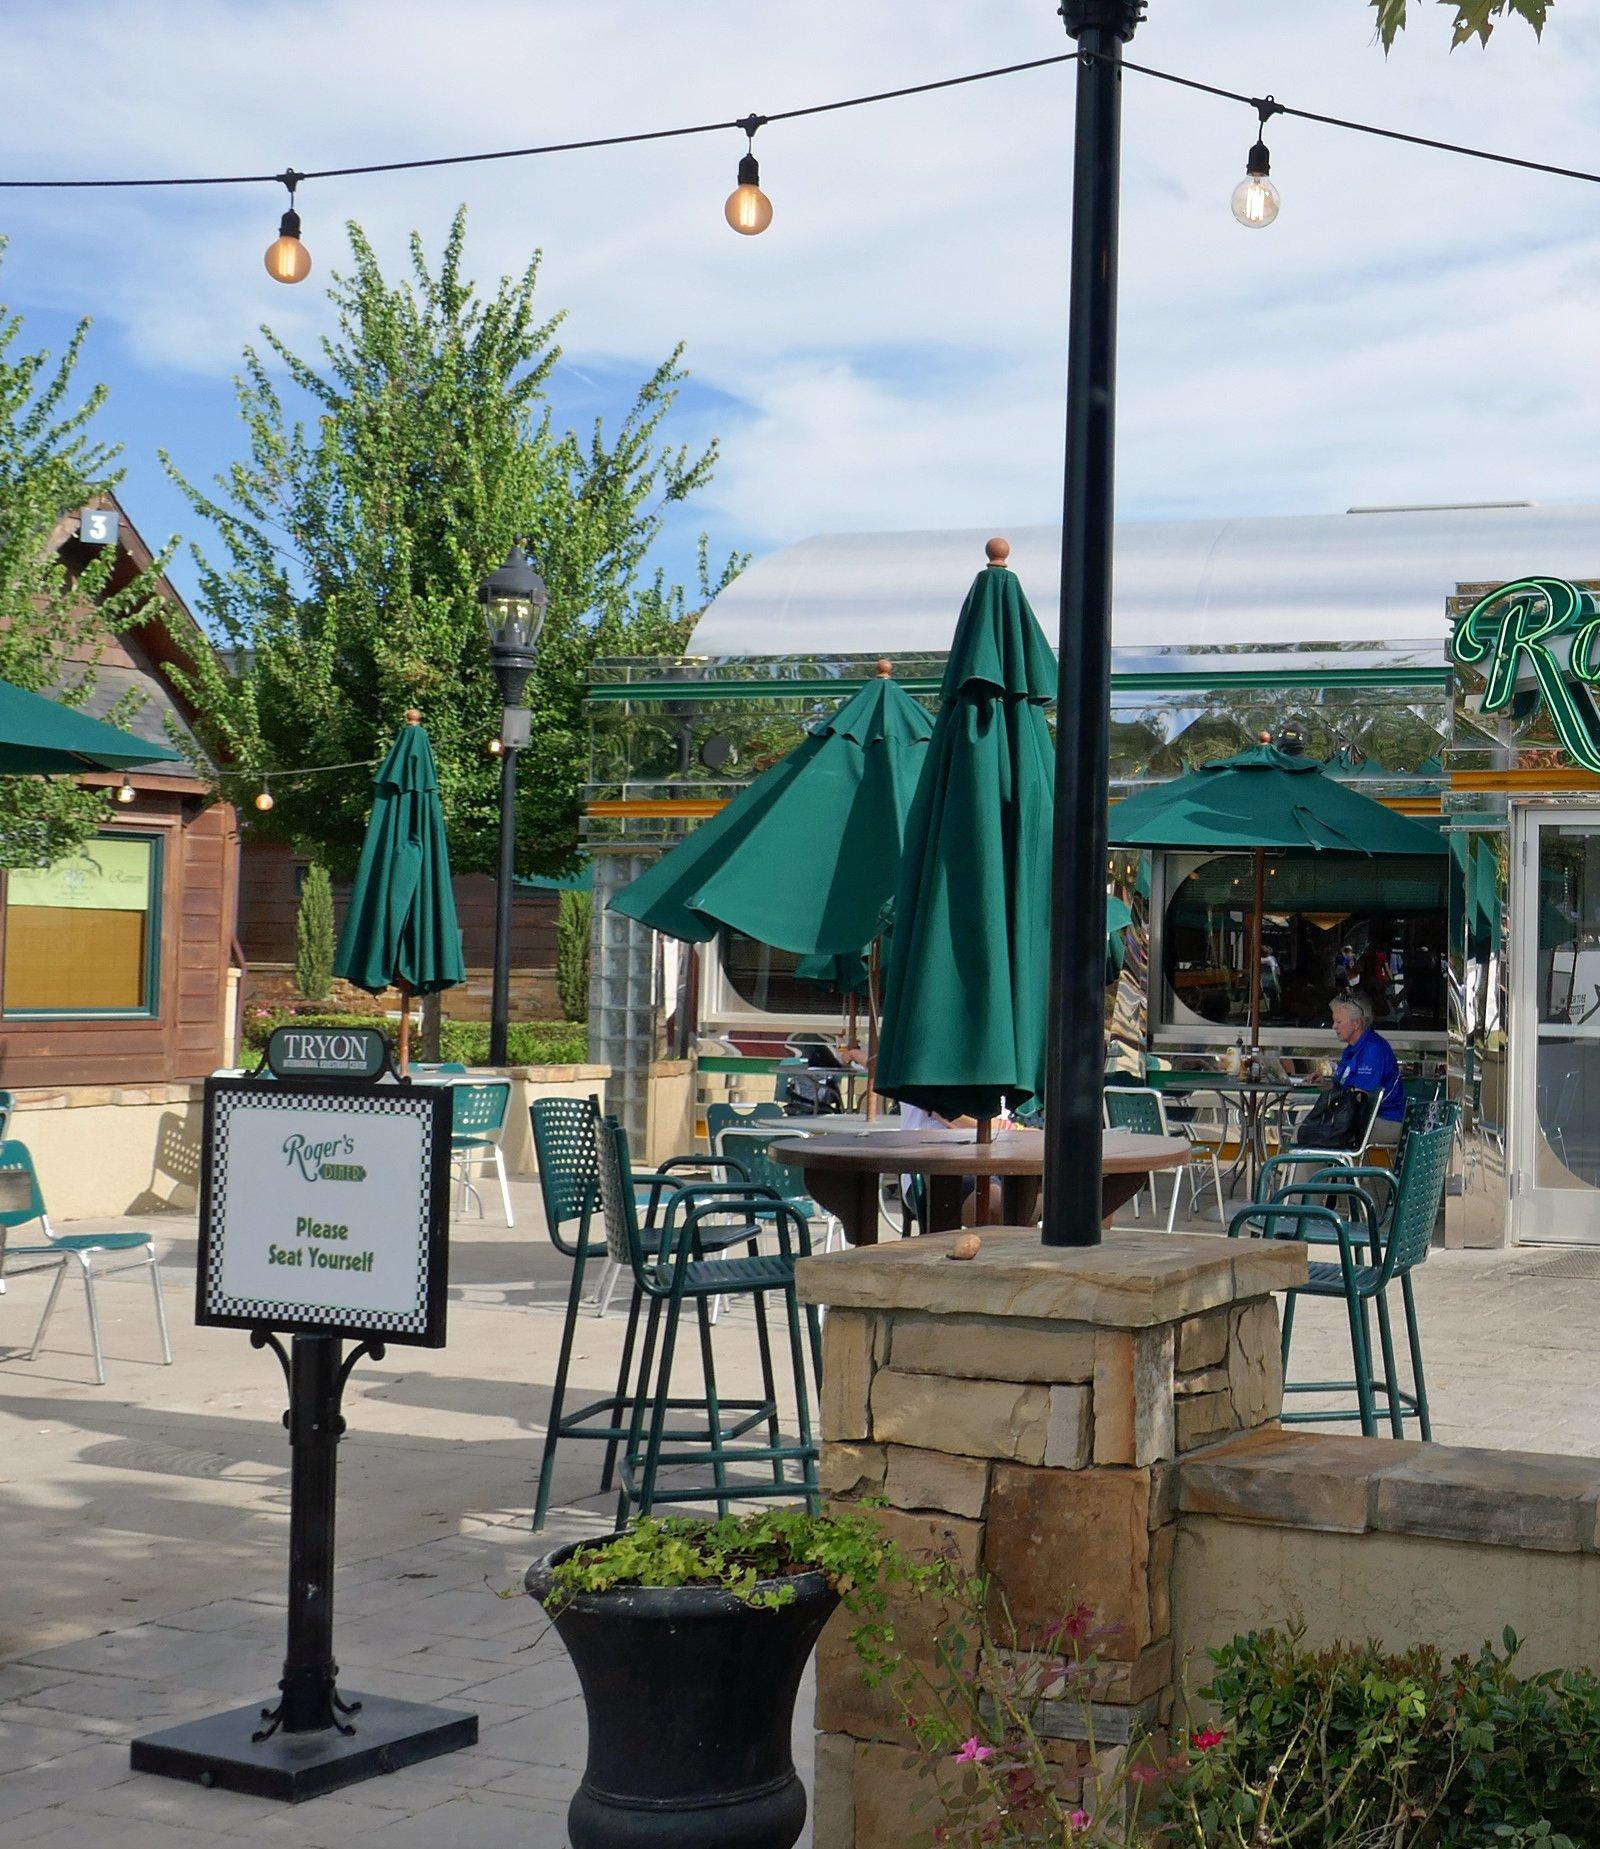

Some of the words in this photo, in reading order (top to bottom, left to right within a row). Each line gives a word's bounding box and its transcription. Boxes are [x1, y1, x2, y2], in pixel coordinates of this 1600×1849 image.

[89, 515, 107, 540] 3
[283, 1034, 369, 1061] TRYON
[282, 1133, 355, 1183] Roger's
[324, 1164, 360, 1181] DINER
[296, 1216, 349, 1241] Please
[268, 1243, 303, 1266] Seat
[308, 1247, 374, 1273] Yourself
